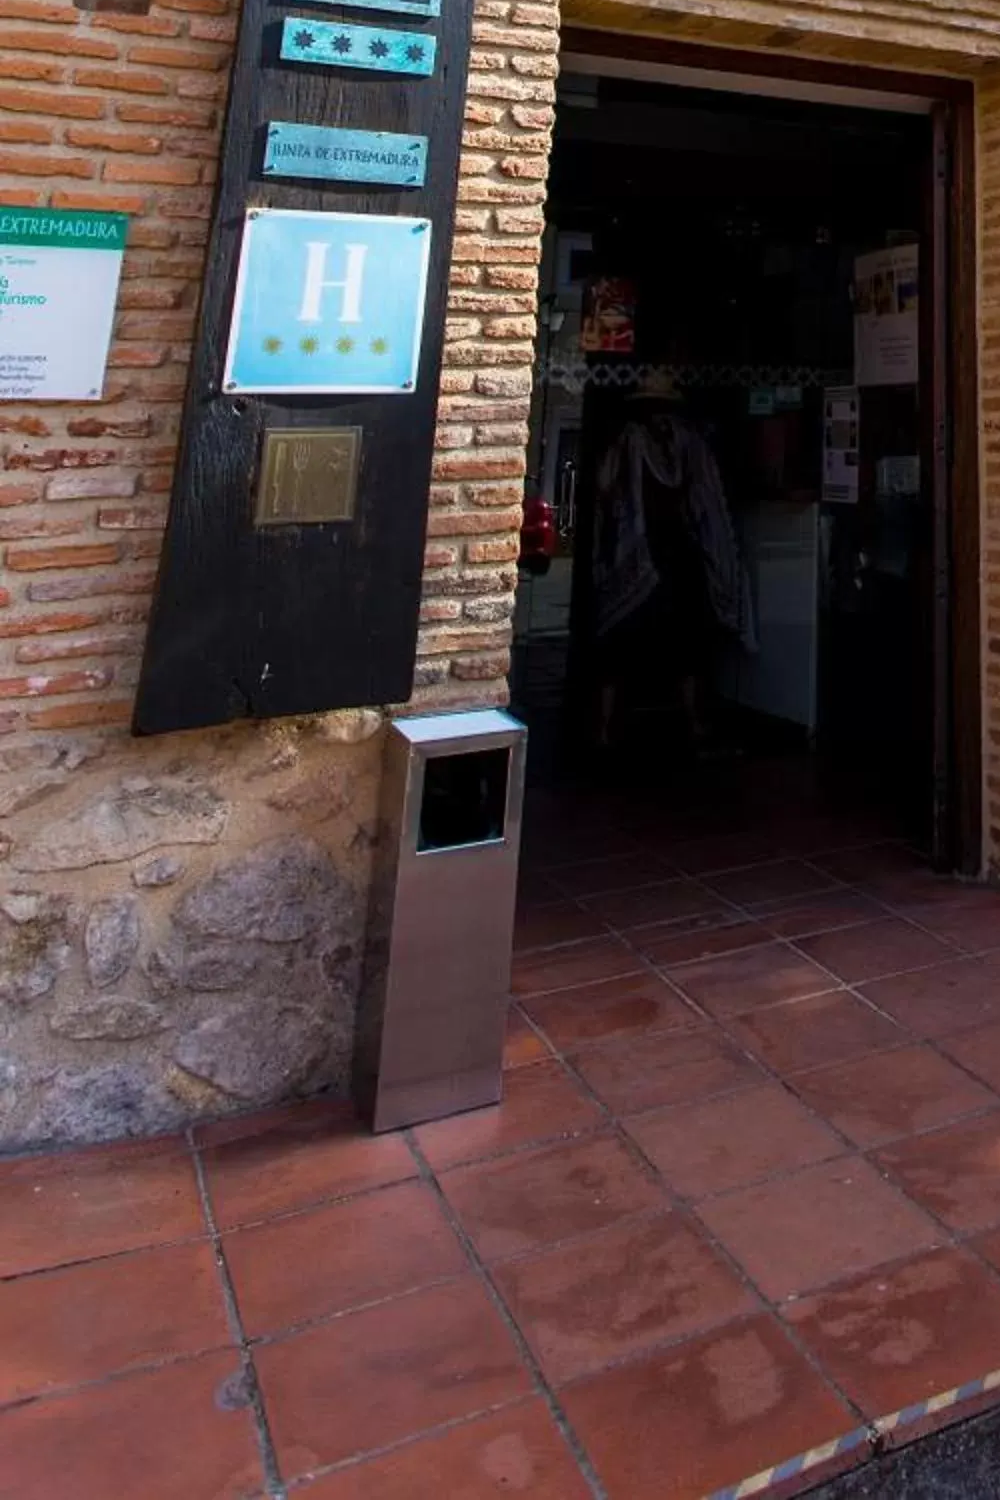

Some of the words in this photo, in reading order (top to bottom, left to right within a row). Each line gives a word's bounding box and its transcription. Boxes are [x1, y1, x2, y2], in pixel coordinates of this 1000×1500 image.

[273, 142, 311, 158] JUNTA
[315, 147, 330, 160] DE
[333, 148, 420, 167] EXTREMADURA
[0, 215, 119, 239] EXTREMADURA
[297, 241, 369, 323] H
